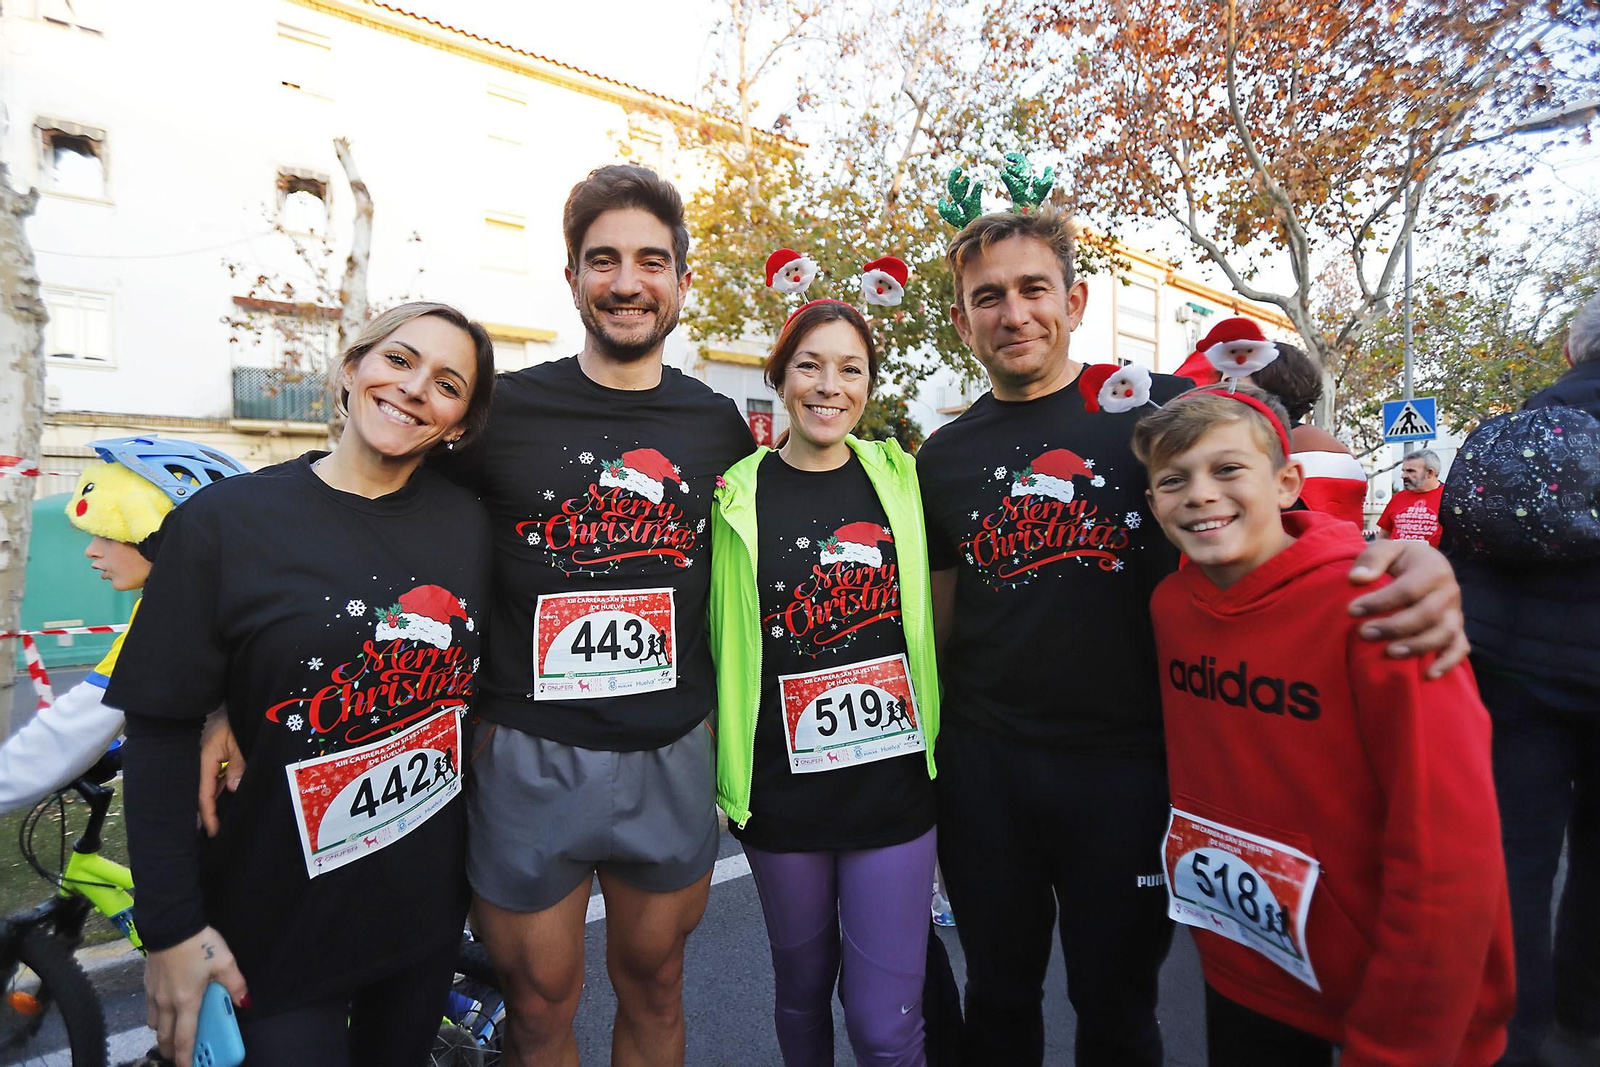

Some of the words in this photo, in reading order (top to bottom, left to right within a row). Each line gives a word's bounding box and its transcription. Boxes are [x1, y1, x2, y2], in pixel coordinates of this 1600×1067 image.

[562, 483, 684, 526] Merry
[982, 495, 1098, 530] Merry
[515, 514, 697, 550] Christmas
[958, 517, 1131, 567] Christmas
[793, 561, 898, 600] Merry
[570, 619, 644, 662] 443
[331, 638, 468, 685] Merry
[813, 673, 840, 683] CARRERA
[852, 665, 880, 676] SILVESTRE
[836, 677, 858, 685] HUELVA
[1169, 655, 1322, 721] adidas
[815, 689, 883, 737] 519
[335, 759, 349, 768] XIII
[349, 747, 385, 764] CARRERA
[385, 740, 401, 751] SAN
[401, 724, 432, 745] SILVESTRE
[369, 756, 380, 766] DE
[380, 745, 407, 762] HUELVA
[349, 752, 432, 819] 442
[1199, 826, 1225, 840] CARRERA
[1225, 833, 1239, 844] SAN
[1238, 838, 1273, 857] SILVESTRE
[1209, 839, 1219, 847] DE
[1137, 874, 1167, 888] PUM
[1191, 852, 1261, 923] 518
